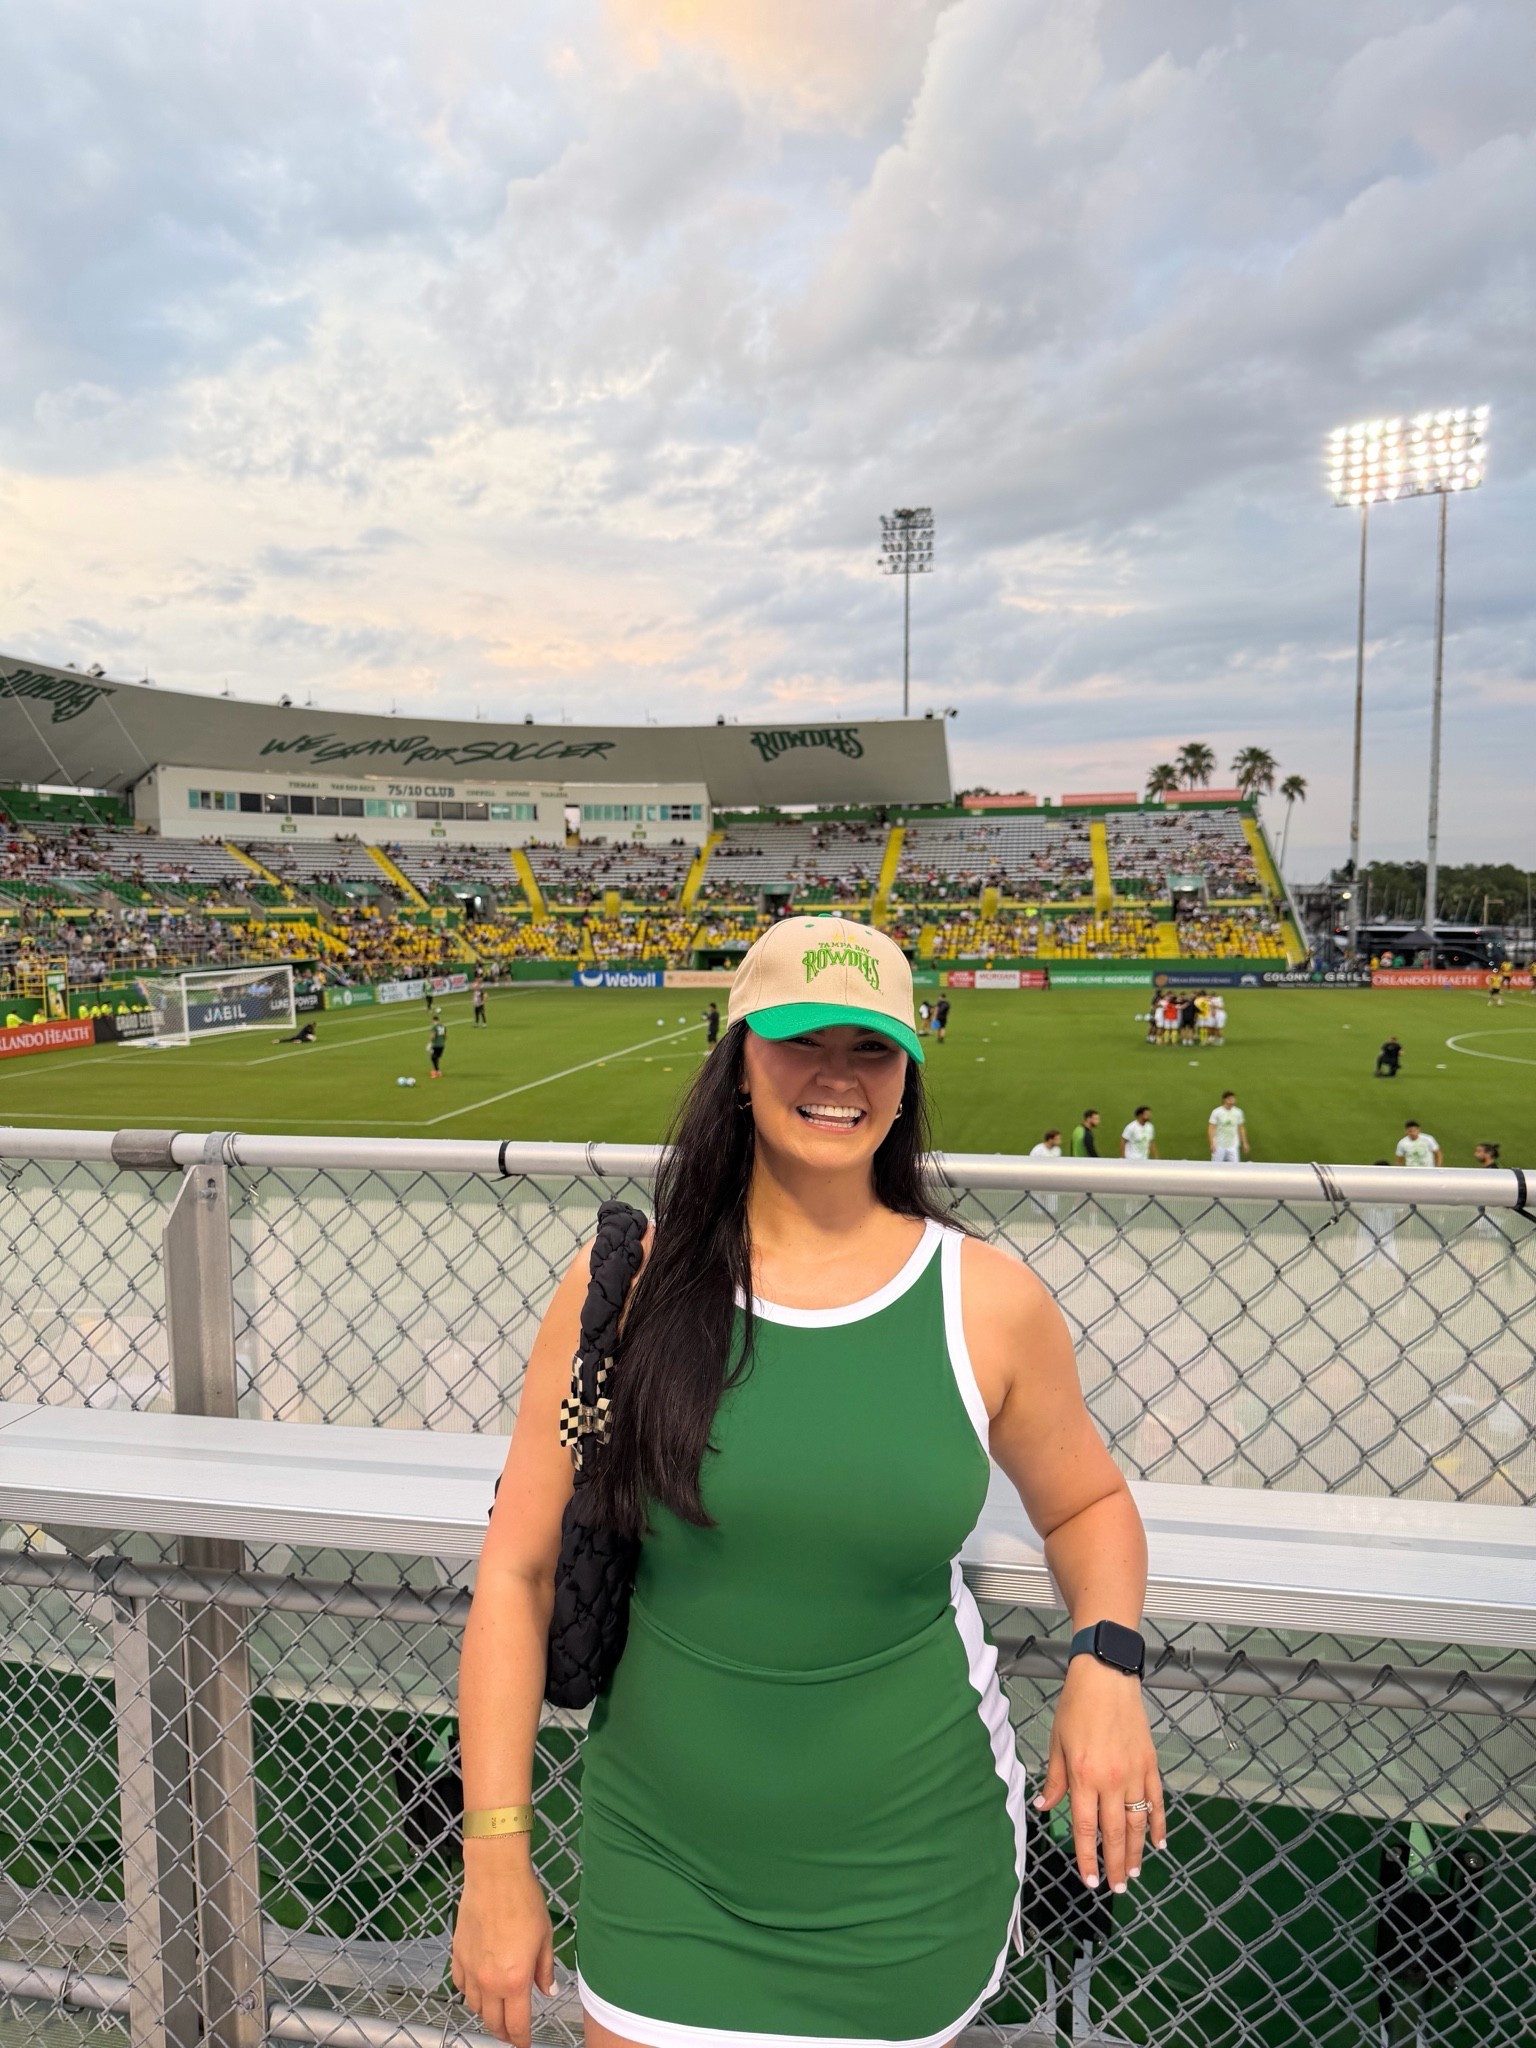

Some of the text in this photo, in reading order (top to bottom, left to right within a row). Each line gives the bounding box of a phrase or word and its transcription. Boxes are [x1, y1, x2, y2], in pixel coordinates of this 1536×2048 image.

[0, 669, 117, 724] OWDIES
[259, 733, 616, 766] WE STAND FOR SOCCER
[750, 728, 864, 762] ROWDIES
[388, 785, 455, 798] 75/10 CLUB
[855, 944, 870, 953] BAY
[802, 948, 880, 991] ROWDIES
[1263, 972, 1371, 982] COLONY GRILL
[605, 972, 656, 987] Webull
[1050, 975, 1078, 984] UNION
[1079, 975, 1103, 984] HOME
[1104, 975, 1150, 984] MORTGAGE
[1373, 975, 1431, 986] ORLANDO
[1432, 974, 1479, 986] HEALTH
[204, 1004, 247, 1023] JABIL
[0, 1026, 89, 1051] LANDO HEALTH
